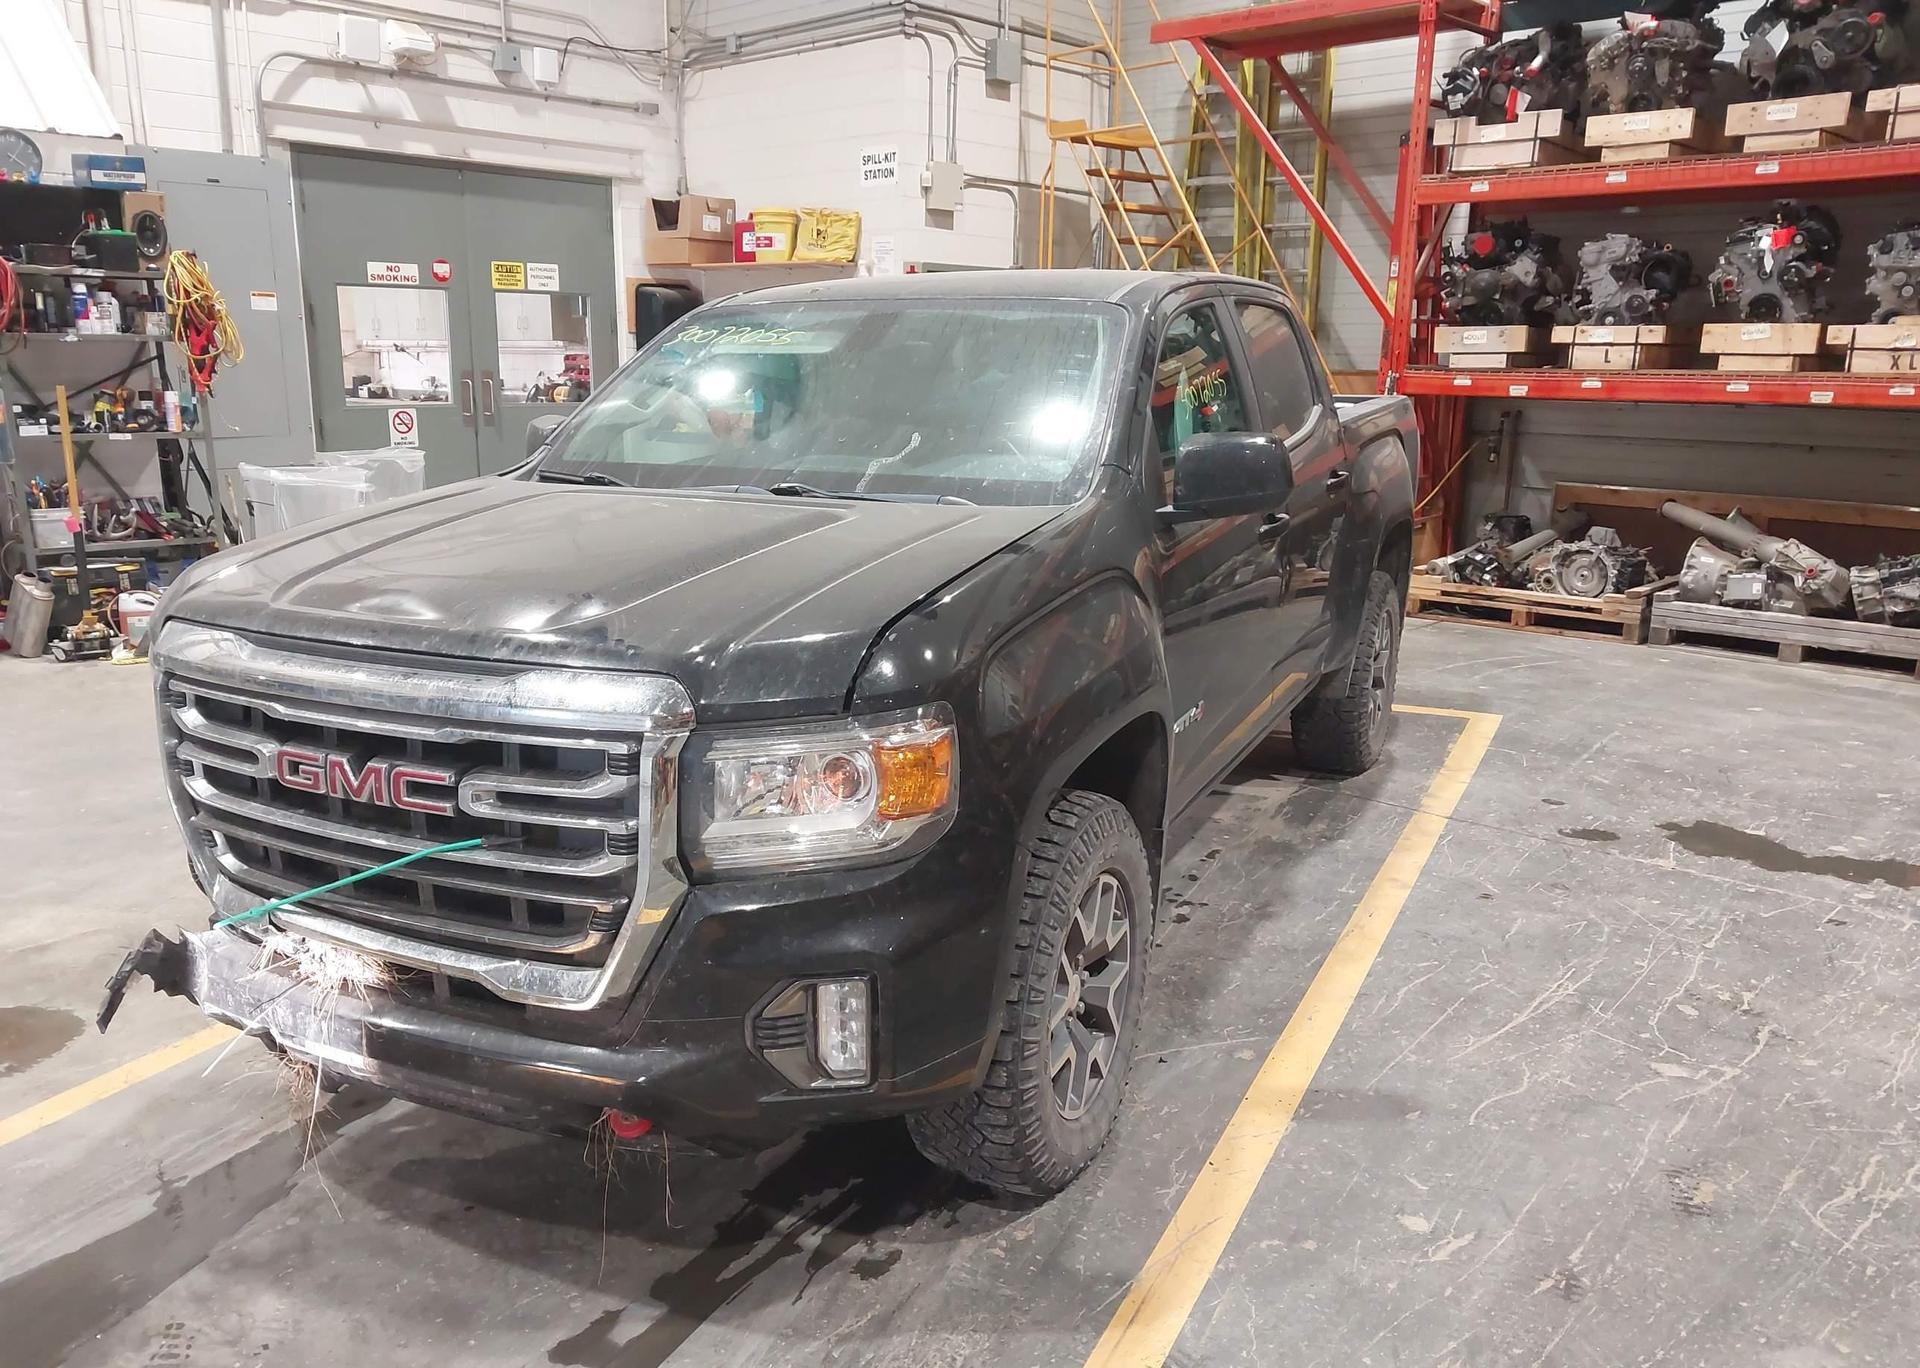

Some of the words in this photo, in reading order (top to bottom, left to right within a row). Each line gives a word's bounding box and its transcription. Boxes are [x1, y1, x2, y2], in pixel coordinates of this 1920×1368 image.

[862, 151, 896, 166] SPILL-KIT
[864, 167, 894, 180] STATION
[386, 264, 401, 273] NO
[494, 265, 521, 273] CAUTION
[370, 273, 417, 283] SMOKING
[661, 325, 806, 351] 30072055
[1604, 348, 1611, 364] L
[276, 749, 456, 817] GMC
